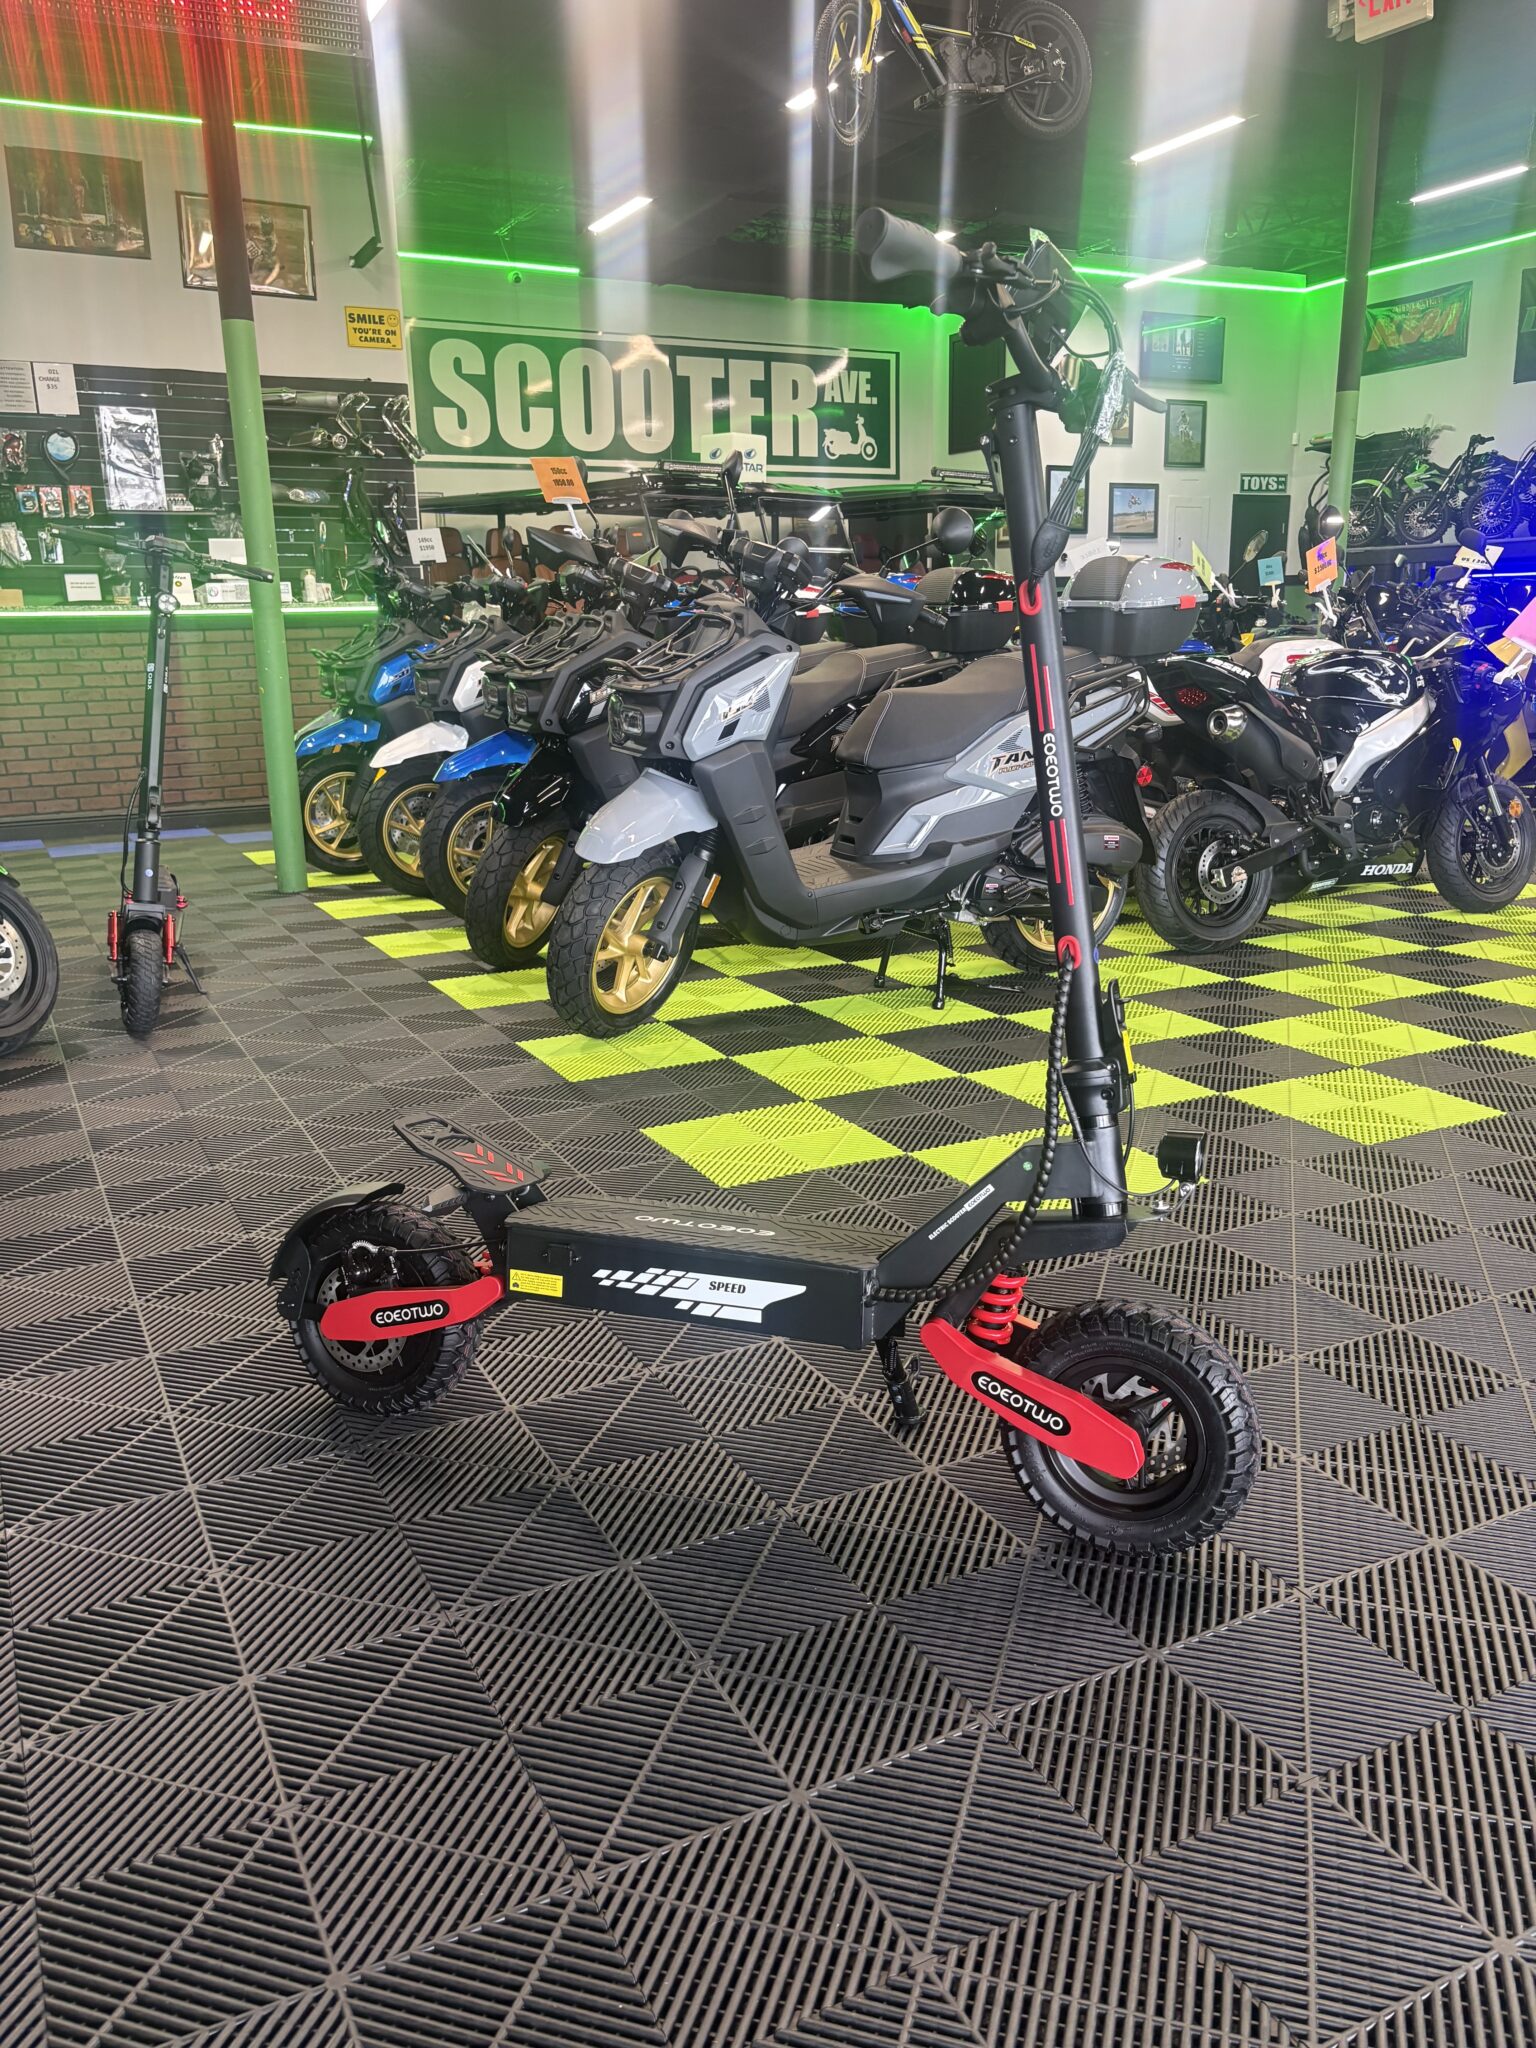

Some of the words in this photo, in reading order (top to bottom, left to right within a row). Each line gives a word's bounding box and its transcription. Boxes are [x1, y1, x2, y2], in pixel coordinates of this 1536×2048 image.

[348, 312, 385, 326] SMILE
[352, 327, 382, 336] YOU'RE
[385, 329, 397, 337] ON
[358, 335, 392, 344] CAMERA
[429, 338, 818, 458] SCOOTER
[823, 369, 878, 405] AVE.
[741, 462, 764, 473] TAR
[1242, 476, 1278, 491] TOYS
[1043, 733, 1063, 817] EOEOTWO
[1360, 862, 1414, 876] HONDA
[634, 1215, 776, 1236] EOEOTWO
[708, 1280, 746, 1294] SPEED
[375, 1303, 444, 1324] EOEOTWO
[977, 1375, 1064, 1431] EOEOTWO
